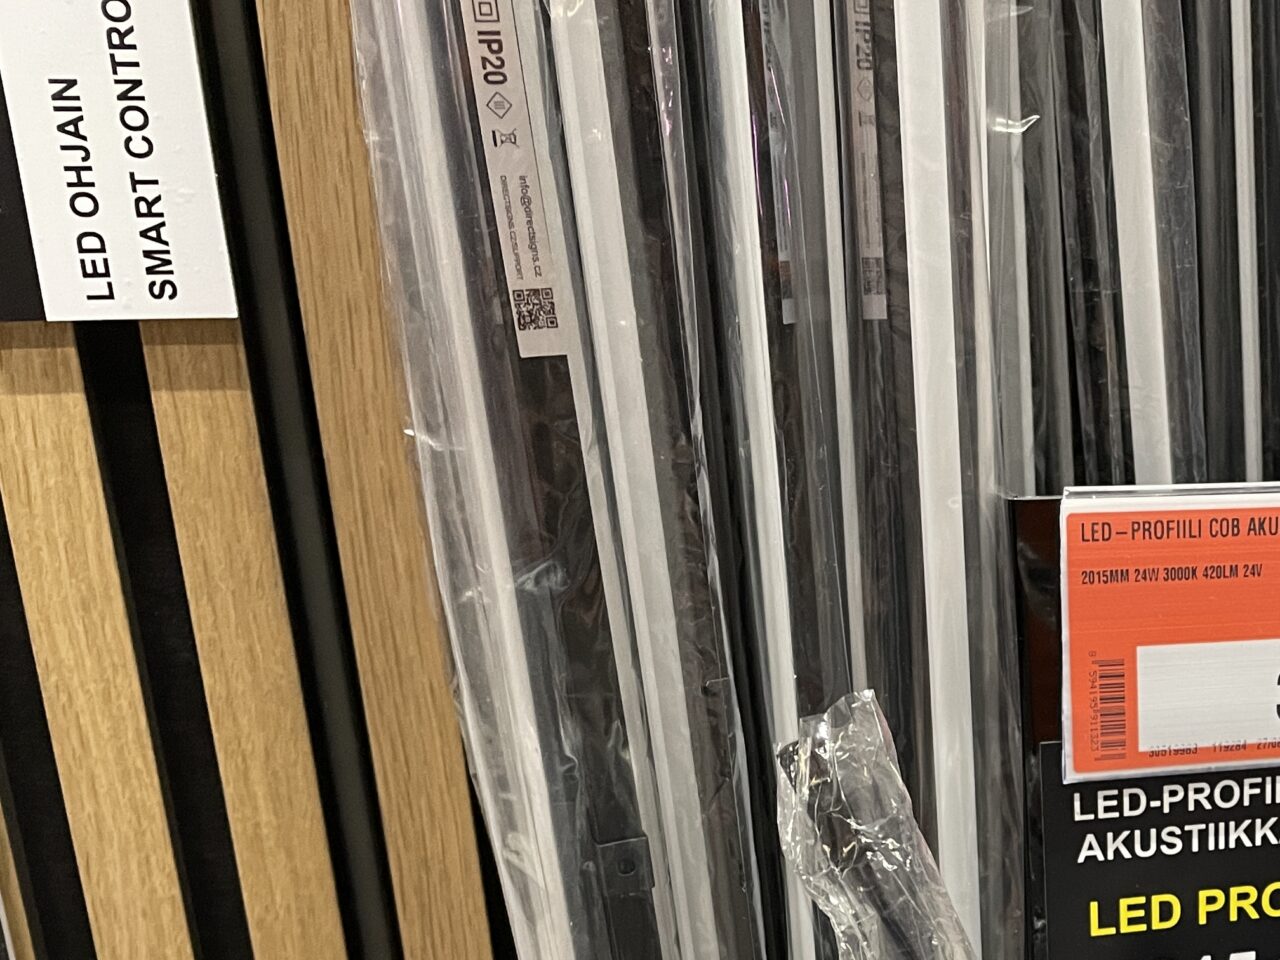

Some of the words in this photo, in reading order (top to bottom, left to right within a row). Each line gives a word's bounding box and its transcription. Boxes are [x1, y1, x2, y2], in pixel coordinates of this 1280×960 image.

[100, 0, 154, 159] CONTRO
[477, 30, 507, 85] IP20
[48, 78, 99, 217] OHJAIN
[76, 231, 115, 300] LED
[129, 171, 178, 300] SMART
[1209, 516, 1241, 538] COB
[1081, 568, 1130, 585] 2015MM
[1134, 567, 1159, 583] 24W
[1163, 566, 1198, 582] 3000K
[1202, 564, 1239, 580] 420LM
[1243, 563, 1263, 578] 24V
[1089, 893, 1181, 937] LED
